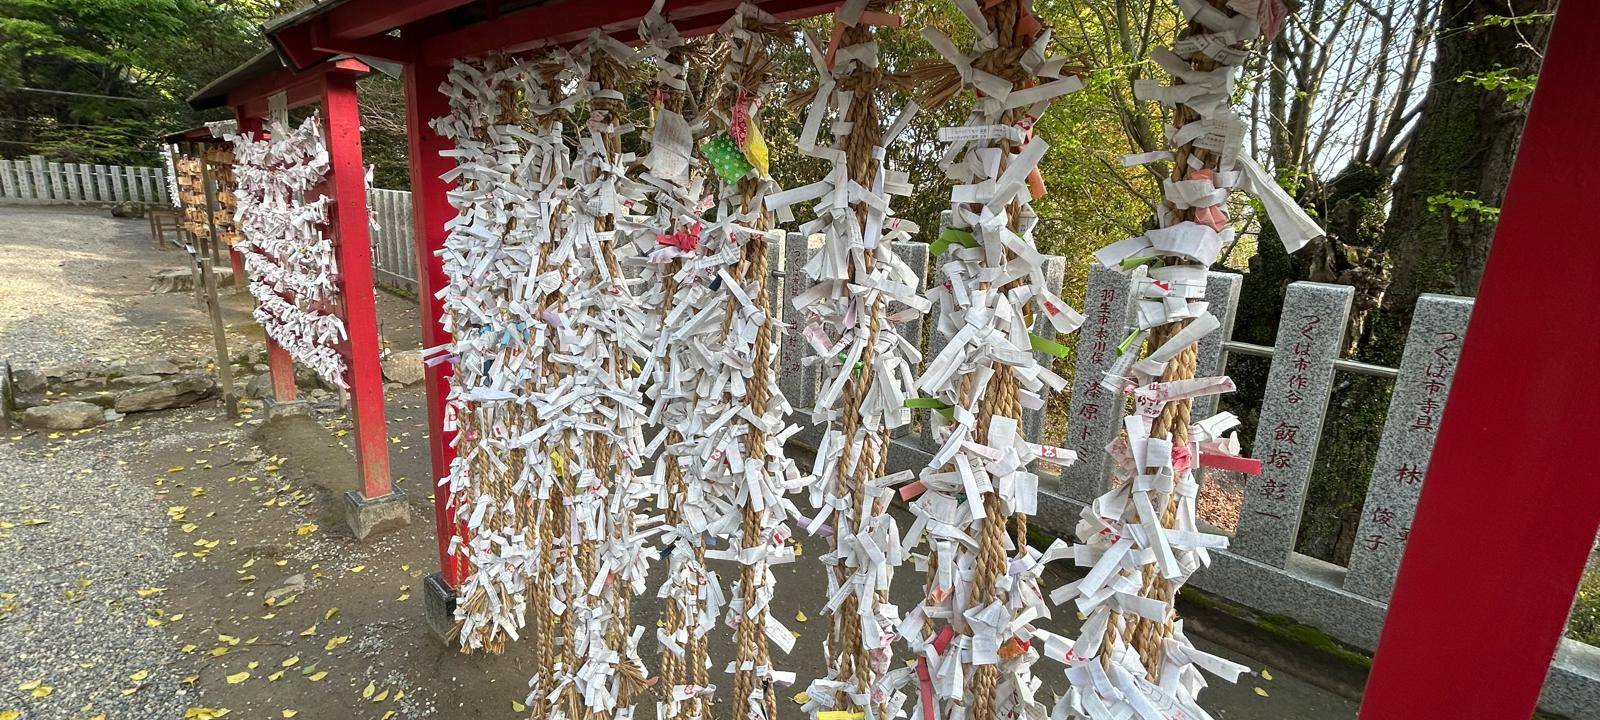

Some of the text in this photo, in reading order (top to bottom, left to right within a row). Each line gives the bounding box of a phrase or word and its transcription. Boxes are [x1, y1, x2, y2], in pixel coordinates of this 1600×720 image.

[1256, 314, 1321, 520] つくば市作谷 飯塚彰一
[1412, 331, 1458, 433] つくば市寺具
[1397, 463, 1424, 485] 林
[1365, 506, 1395, 551] 俊子
